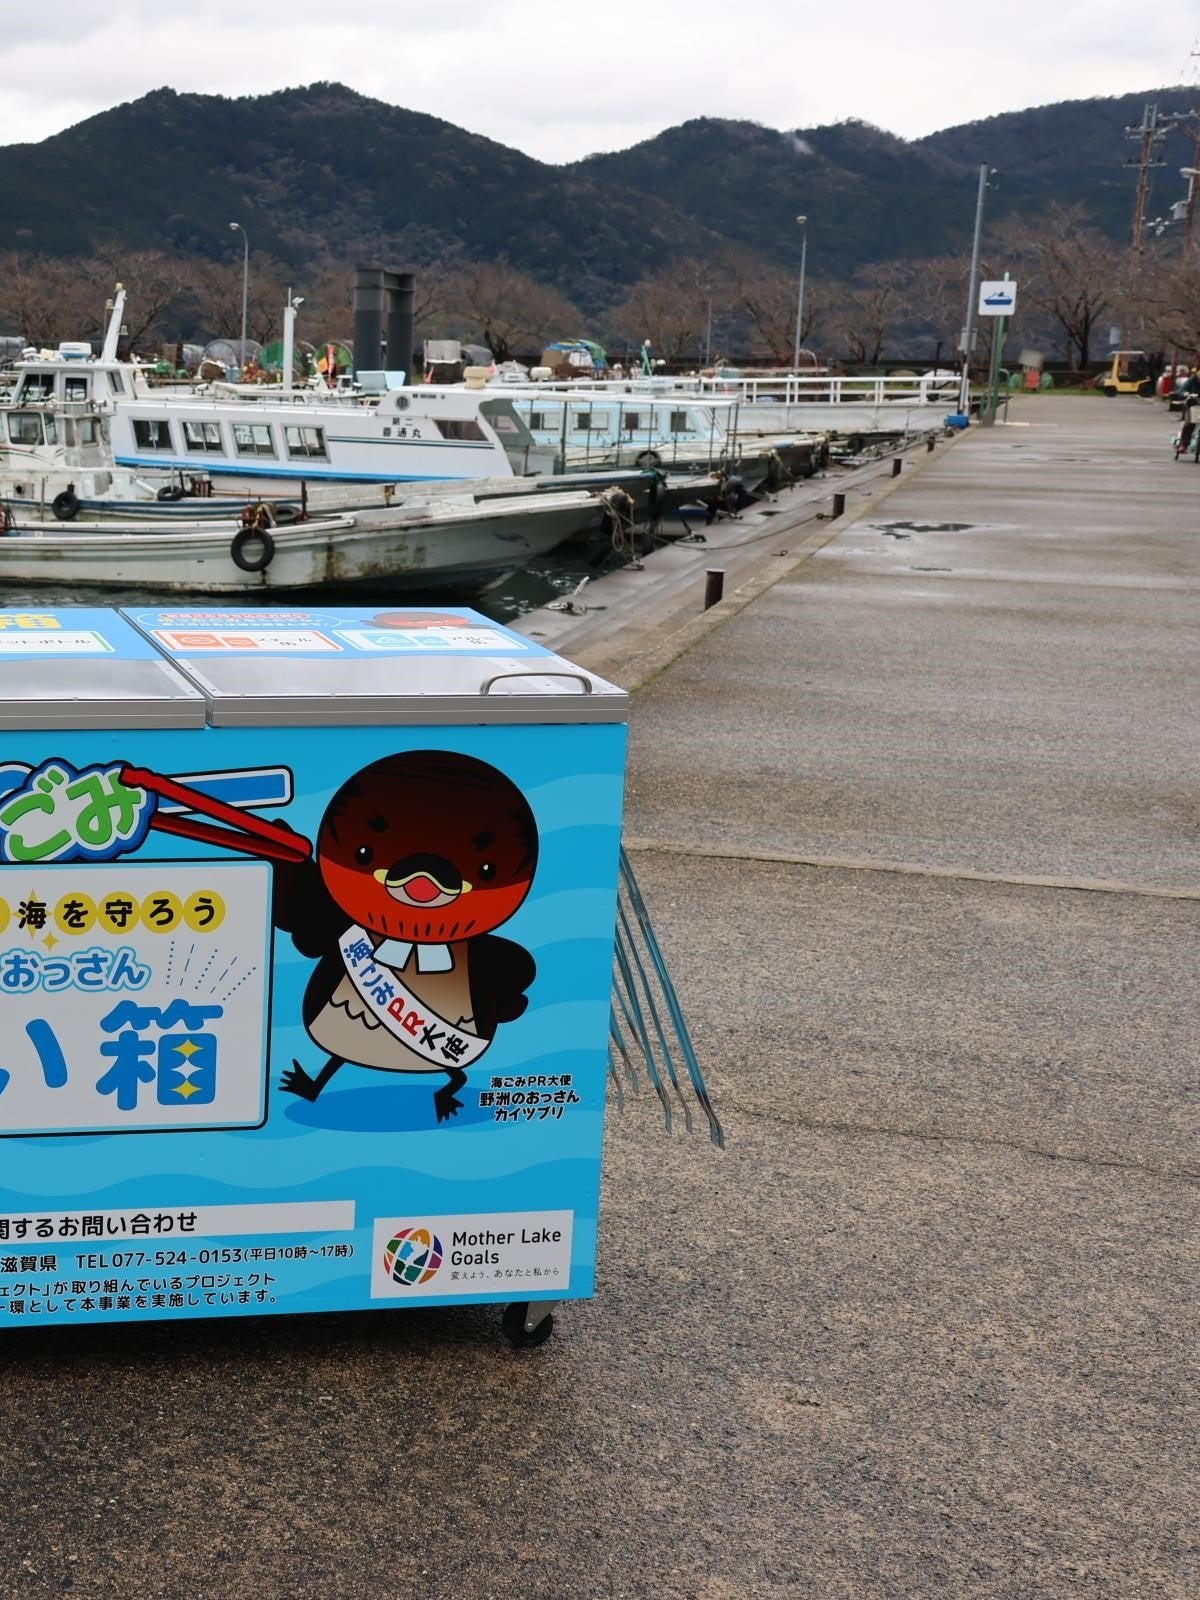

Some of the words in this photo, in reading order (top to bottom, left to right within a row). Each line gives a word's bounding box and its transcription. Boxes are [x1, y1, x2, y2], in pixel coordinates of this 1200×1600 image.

[0, 769, 142, 864] ごみ
[343, 937, 470, 1063] 海ごみPR大使
[490, 1073, 572, 1089] 海ごみPR大使
[479, 1090, 580, 1107] 野洲のおっさん
[495, 1107, 564, 1122] カイツブリ
[452, 1230, 515, 1247] Mother
[521, 1228, 561, 1244] Lake
[0, 1255, 57, 1274] 滋賀県
[451, 1250, 500, 1266] Goals
